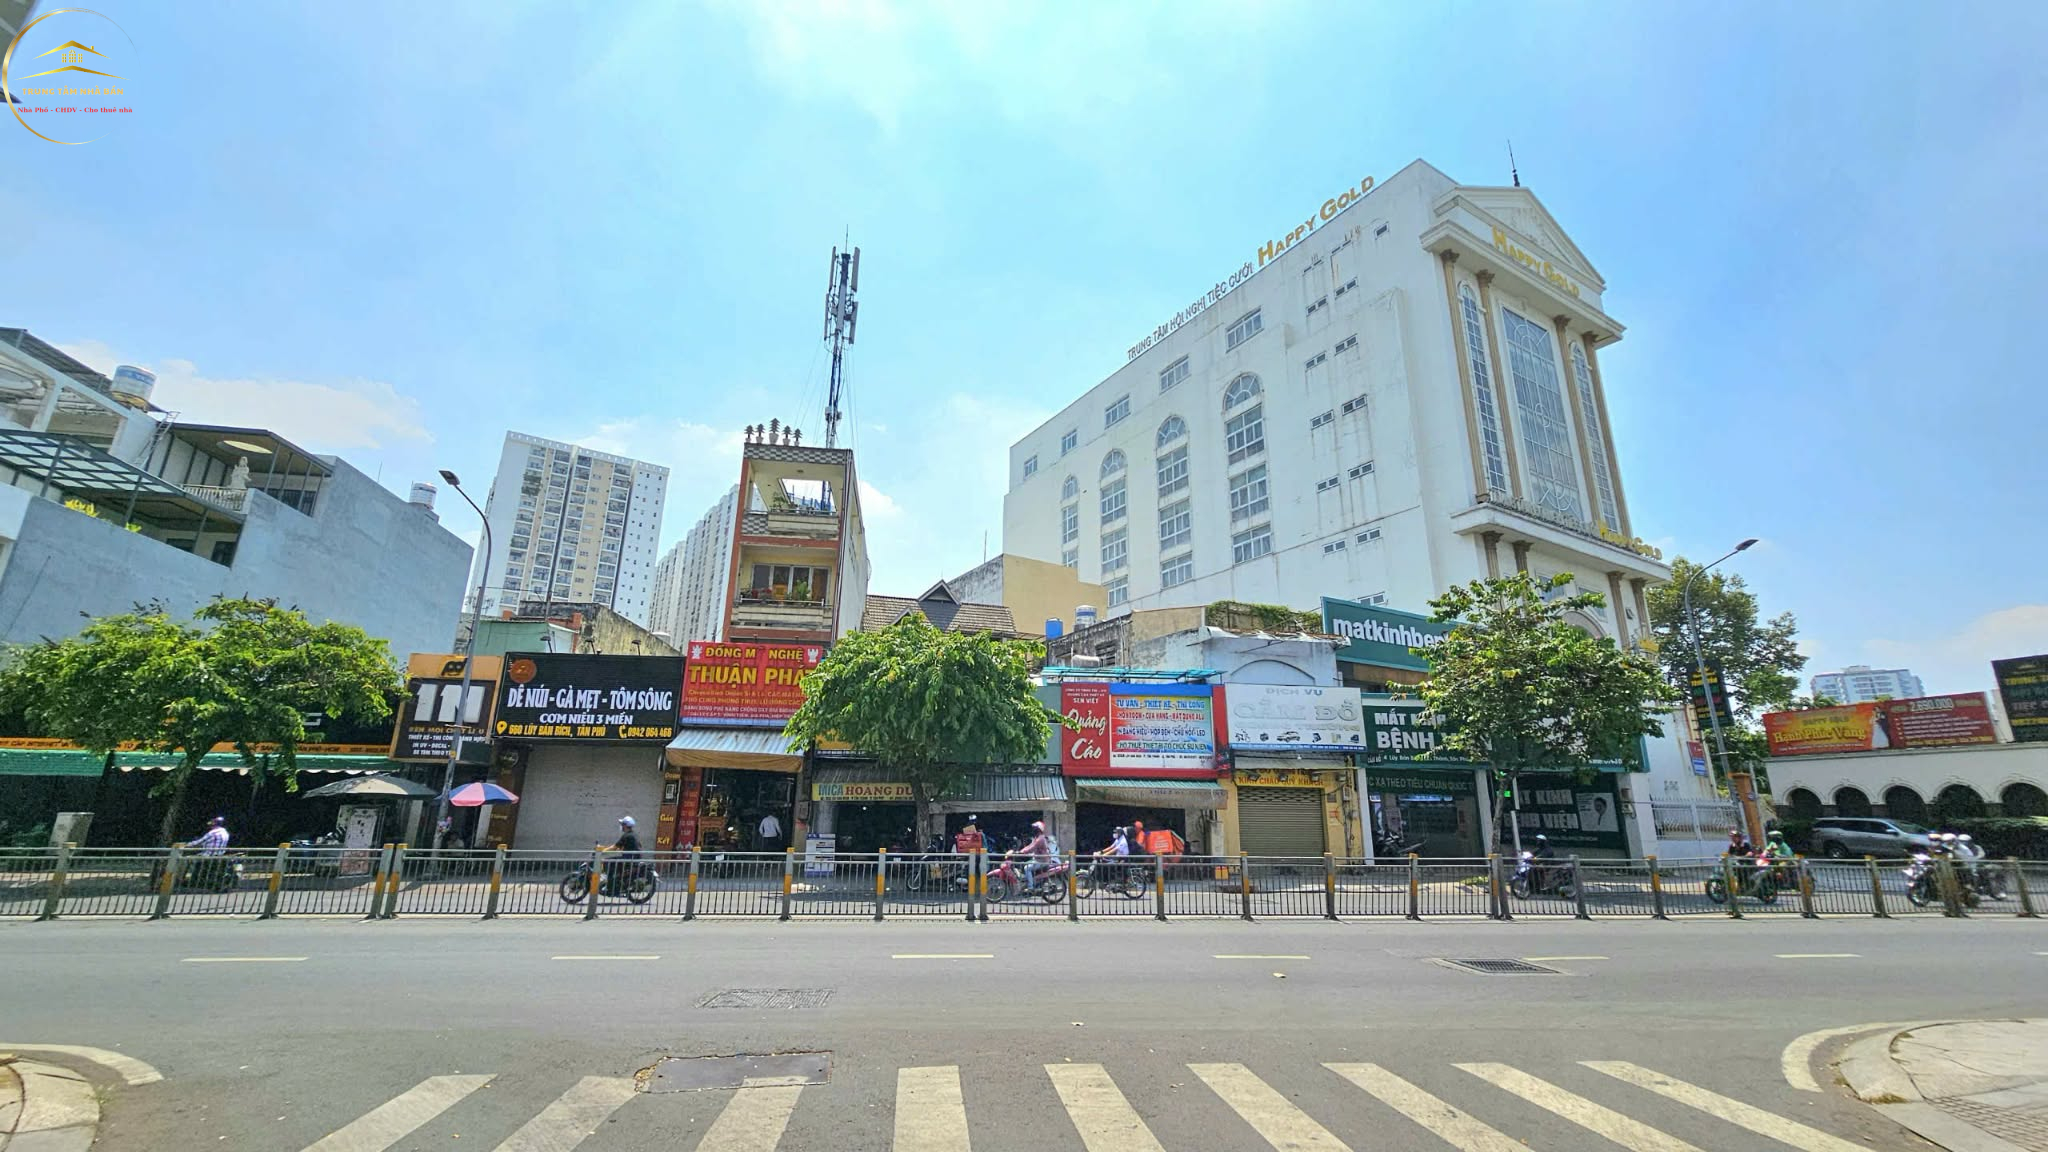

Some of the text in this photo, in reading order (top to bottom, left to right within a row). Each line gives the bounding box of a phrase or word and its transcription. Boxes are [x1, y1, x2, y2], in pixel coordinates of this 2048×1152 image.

[1127, 175, 1374, 360] TRUNG TÂM HỘI NGHỊ TIỆC CƯỚI HAPPY GOLD
[768, 648, 804, 662] NGHỆ
[688, 662, 757, 688] THUẬN
[507, 684, 672, 712] DÊ NÚI GÀ MẸT TÔM SÔNG
[540, 713, 568, 724] CƠM
[568, 712, 594, 724] NIÊU
[596, 714, 603, 724] 3
[1314, 698, 1358, 721] ĐỒ
[1374, 708, 1406, 726] MẮT
[1065, 708, 1106, 736] Quảng
[1071, 738, 1102, 760] Cáo
[1376, 726, 1435, 754] BỆNH
[818, 784, 843, 796] MICA
[1386, 777, 1406, 788] THEO
[1543, 810, 1578, 832] VIỆN
